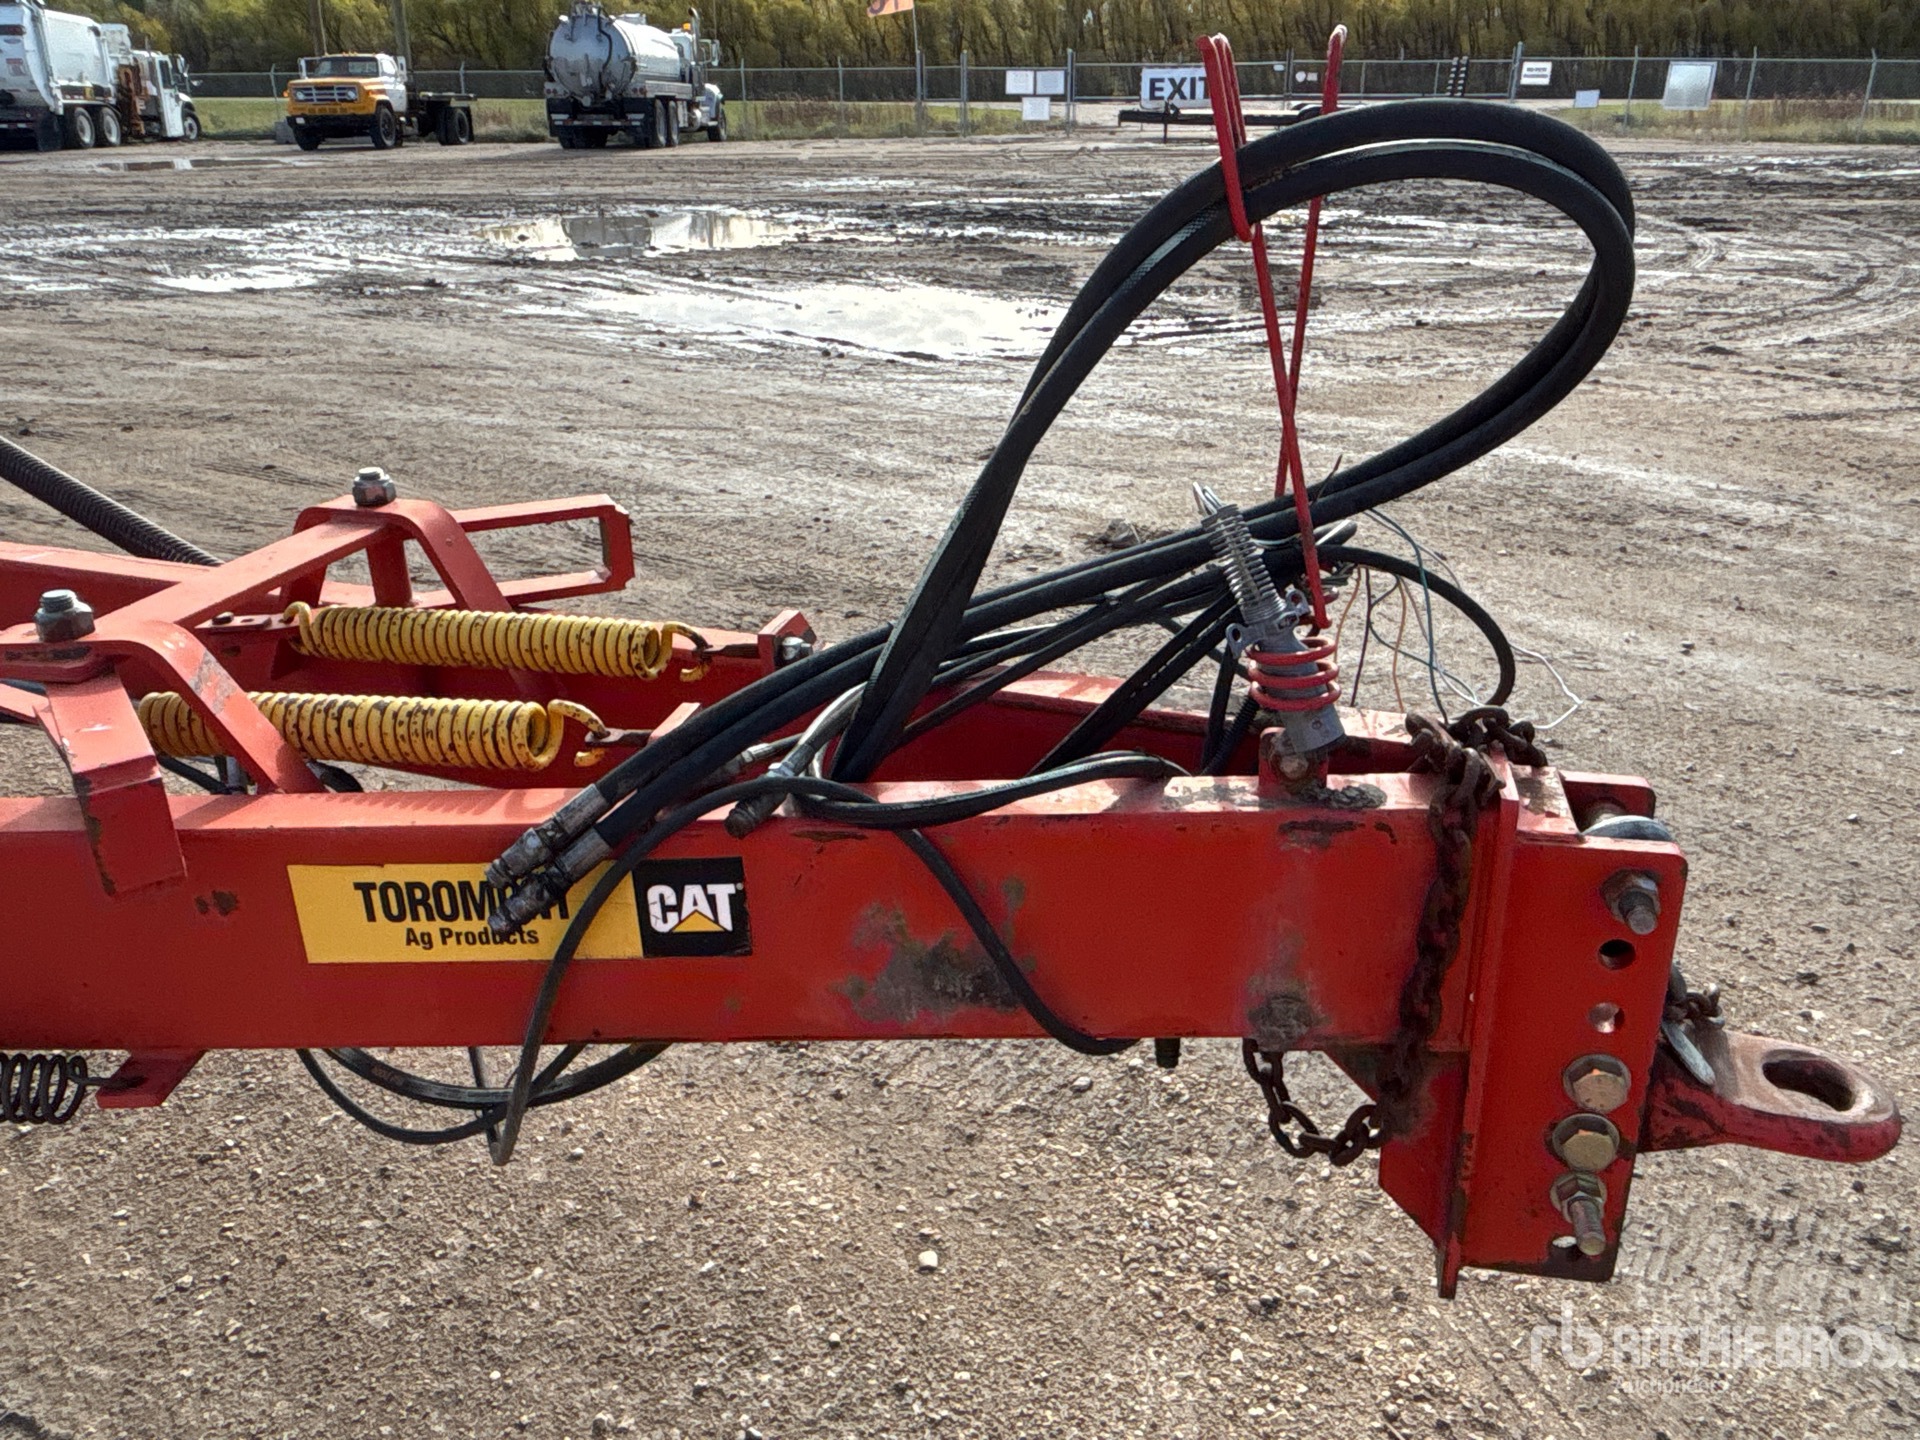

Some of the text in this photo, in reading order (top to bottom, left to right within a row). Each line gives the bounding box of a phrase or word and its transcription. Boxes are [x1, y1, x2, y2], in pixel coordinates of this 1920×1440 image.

[1149, 76, 1210, 100] EXIT
[353, 880, 569, 922] TOROM
[646, 883, 737, 933] CAT
[405, 927, 434, 950] Ag
